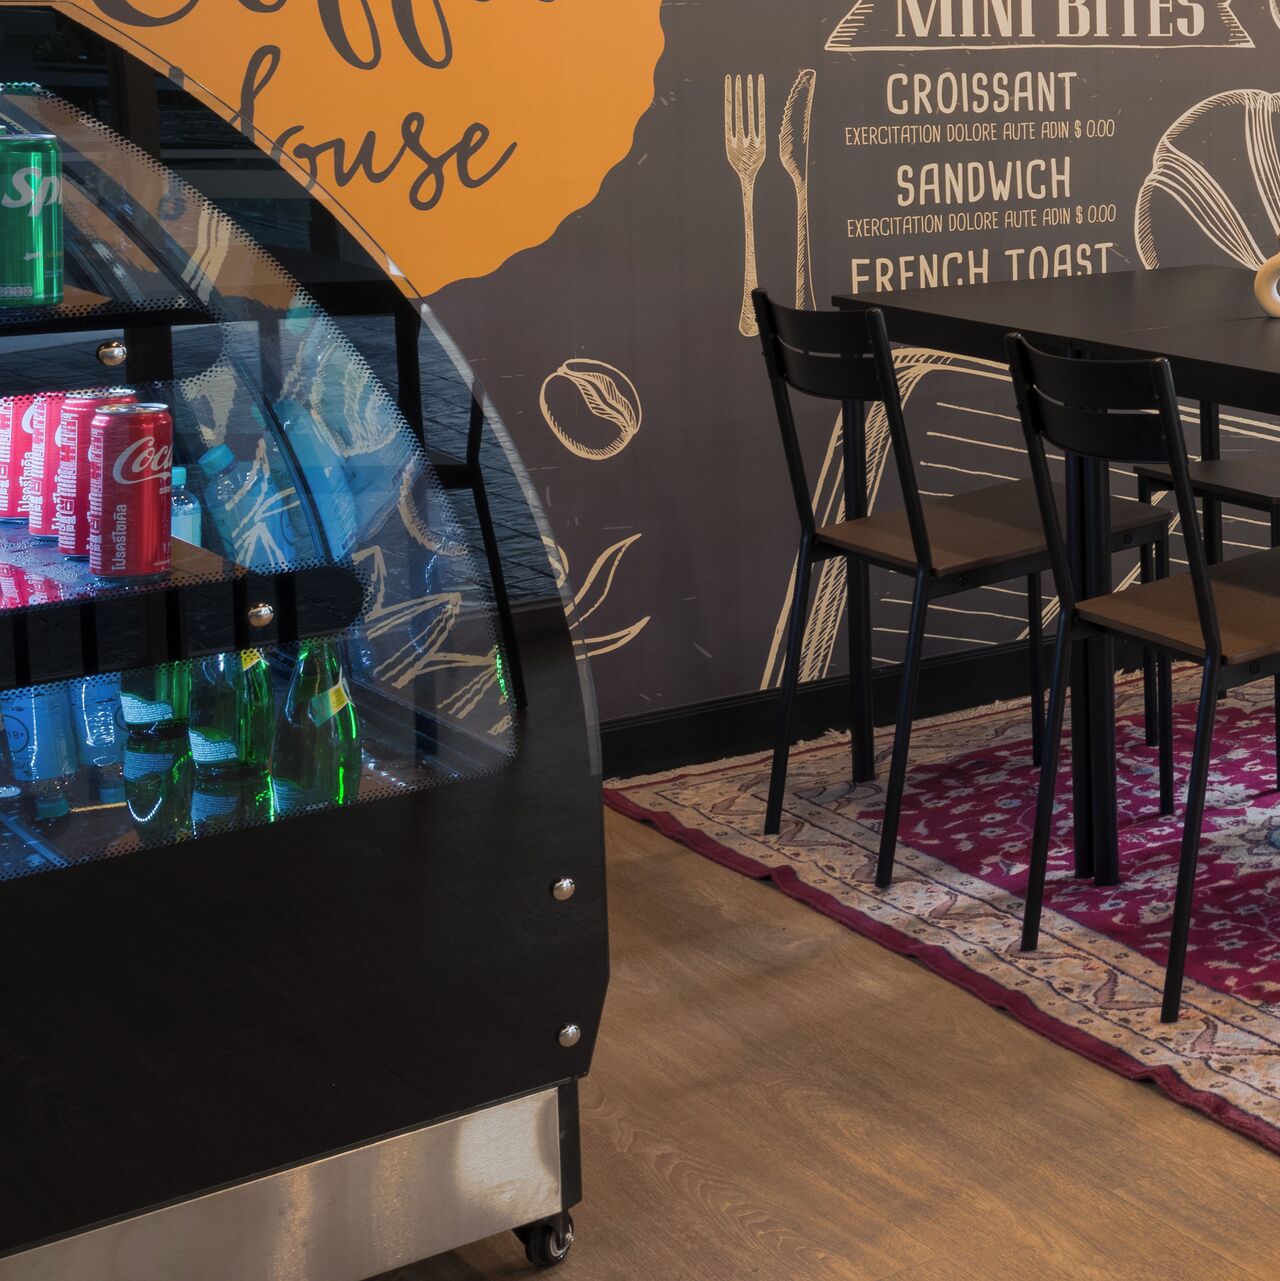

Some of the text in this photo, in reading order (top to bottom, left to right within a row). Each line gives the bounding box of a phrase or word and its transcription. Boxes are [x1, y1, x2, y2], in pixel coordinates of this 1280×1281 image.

[886, 72, 1077, 115] CROISSANT
[846, 120, 1115, 146] EXERCITATION DOLORE AUTE ADIN $ 0.00
[897, 156, 1070, 206] SANDWICH
[848, 204, 1116, 238] EXERCITATION DOLORE AUTE ADIN $ 0.00
[851, 242, 1113, 294] FRENCH TOAST
